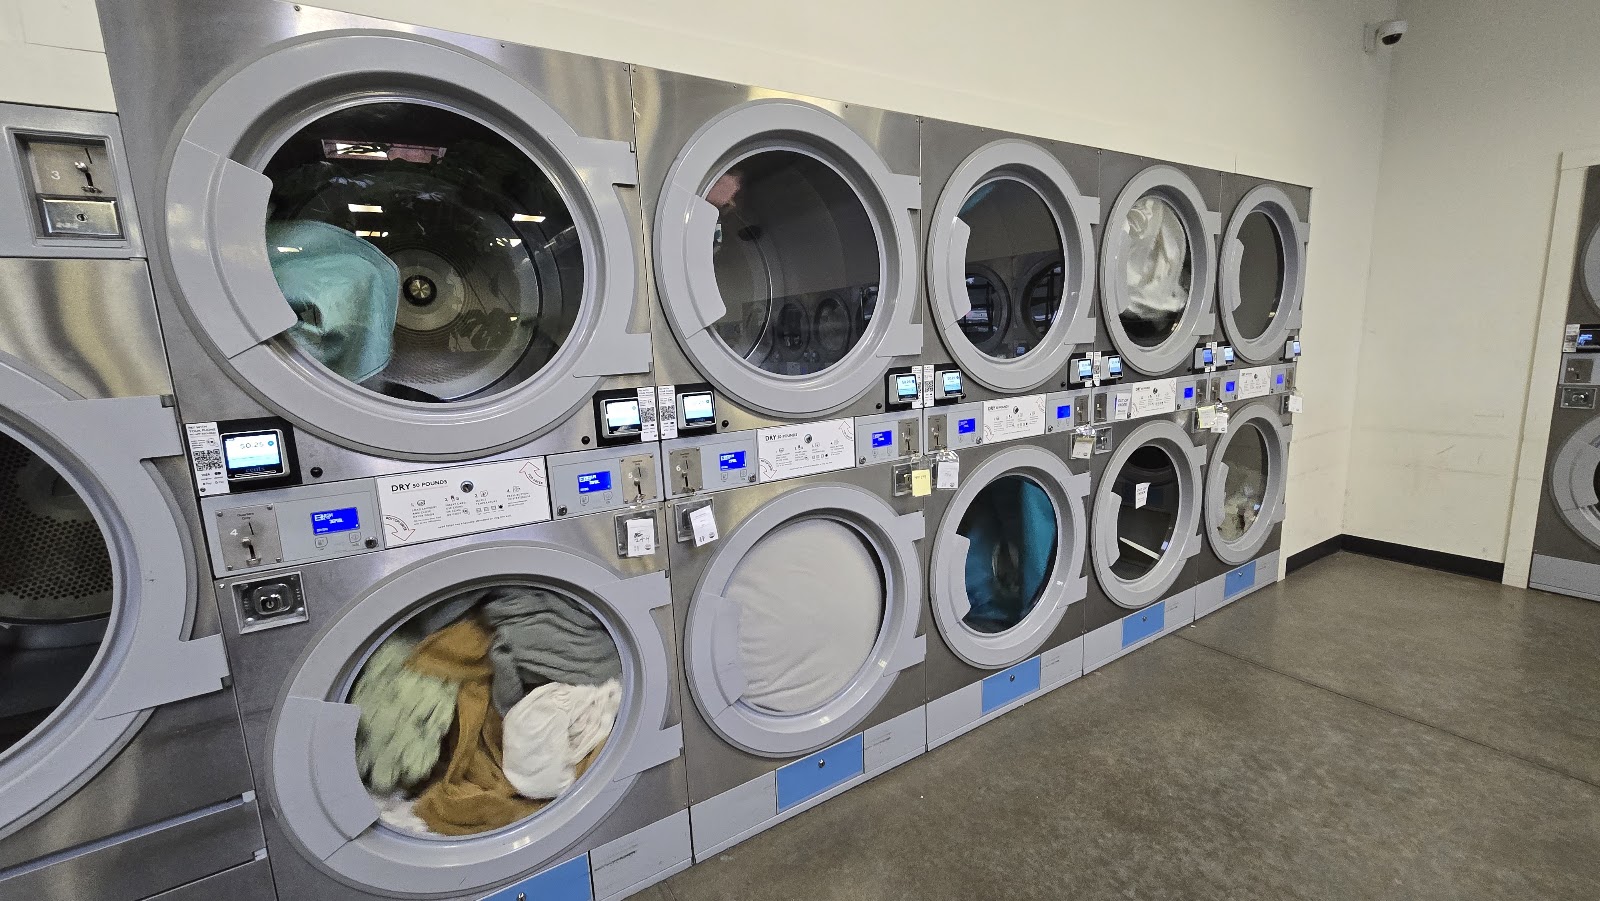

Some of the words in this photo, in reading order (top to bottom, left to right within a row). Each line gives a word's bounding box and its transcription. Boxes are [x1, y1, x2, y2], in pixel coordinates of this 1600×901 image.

[51, 170, 60, 180] 3
[391, 482, 411, 492] DRY
[421, 479, 448, 488] POUNDS
[230, 528, 239, 536] 4
